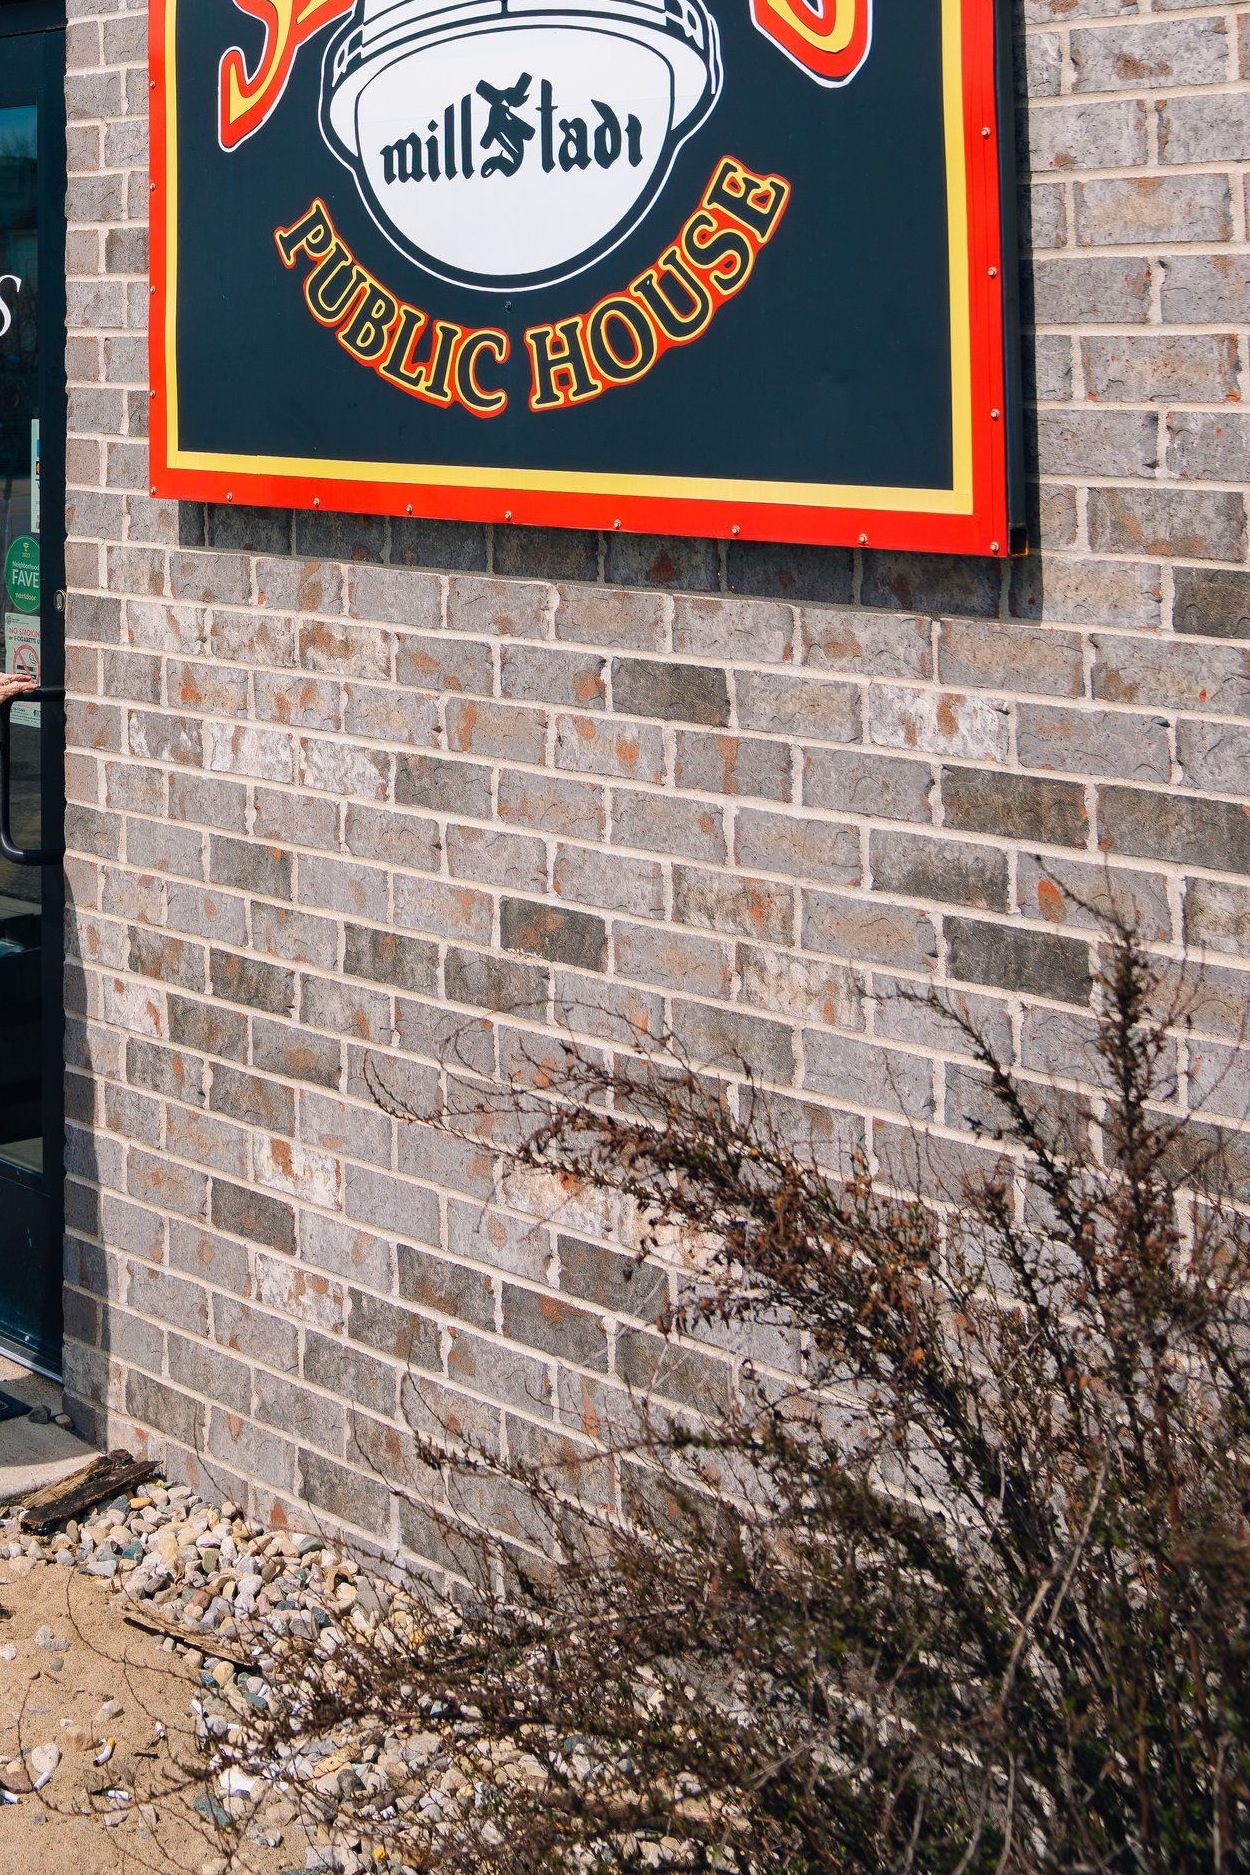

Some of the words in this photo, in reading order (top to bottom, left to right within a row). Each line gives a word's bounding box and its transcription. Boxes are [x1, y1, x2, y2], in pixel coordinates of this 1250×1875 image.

[275, 197, 508, 417] PUBLIC
[526, 155, 791, 413] HOUSE
[12, 568, 39, 589] FAVE
[15, 592, 36, 601] nextdoor
[19, 628, 40, 638] SMOKIN
